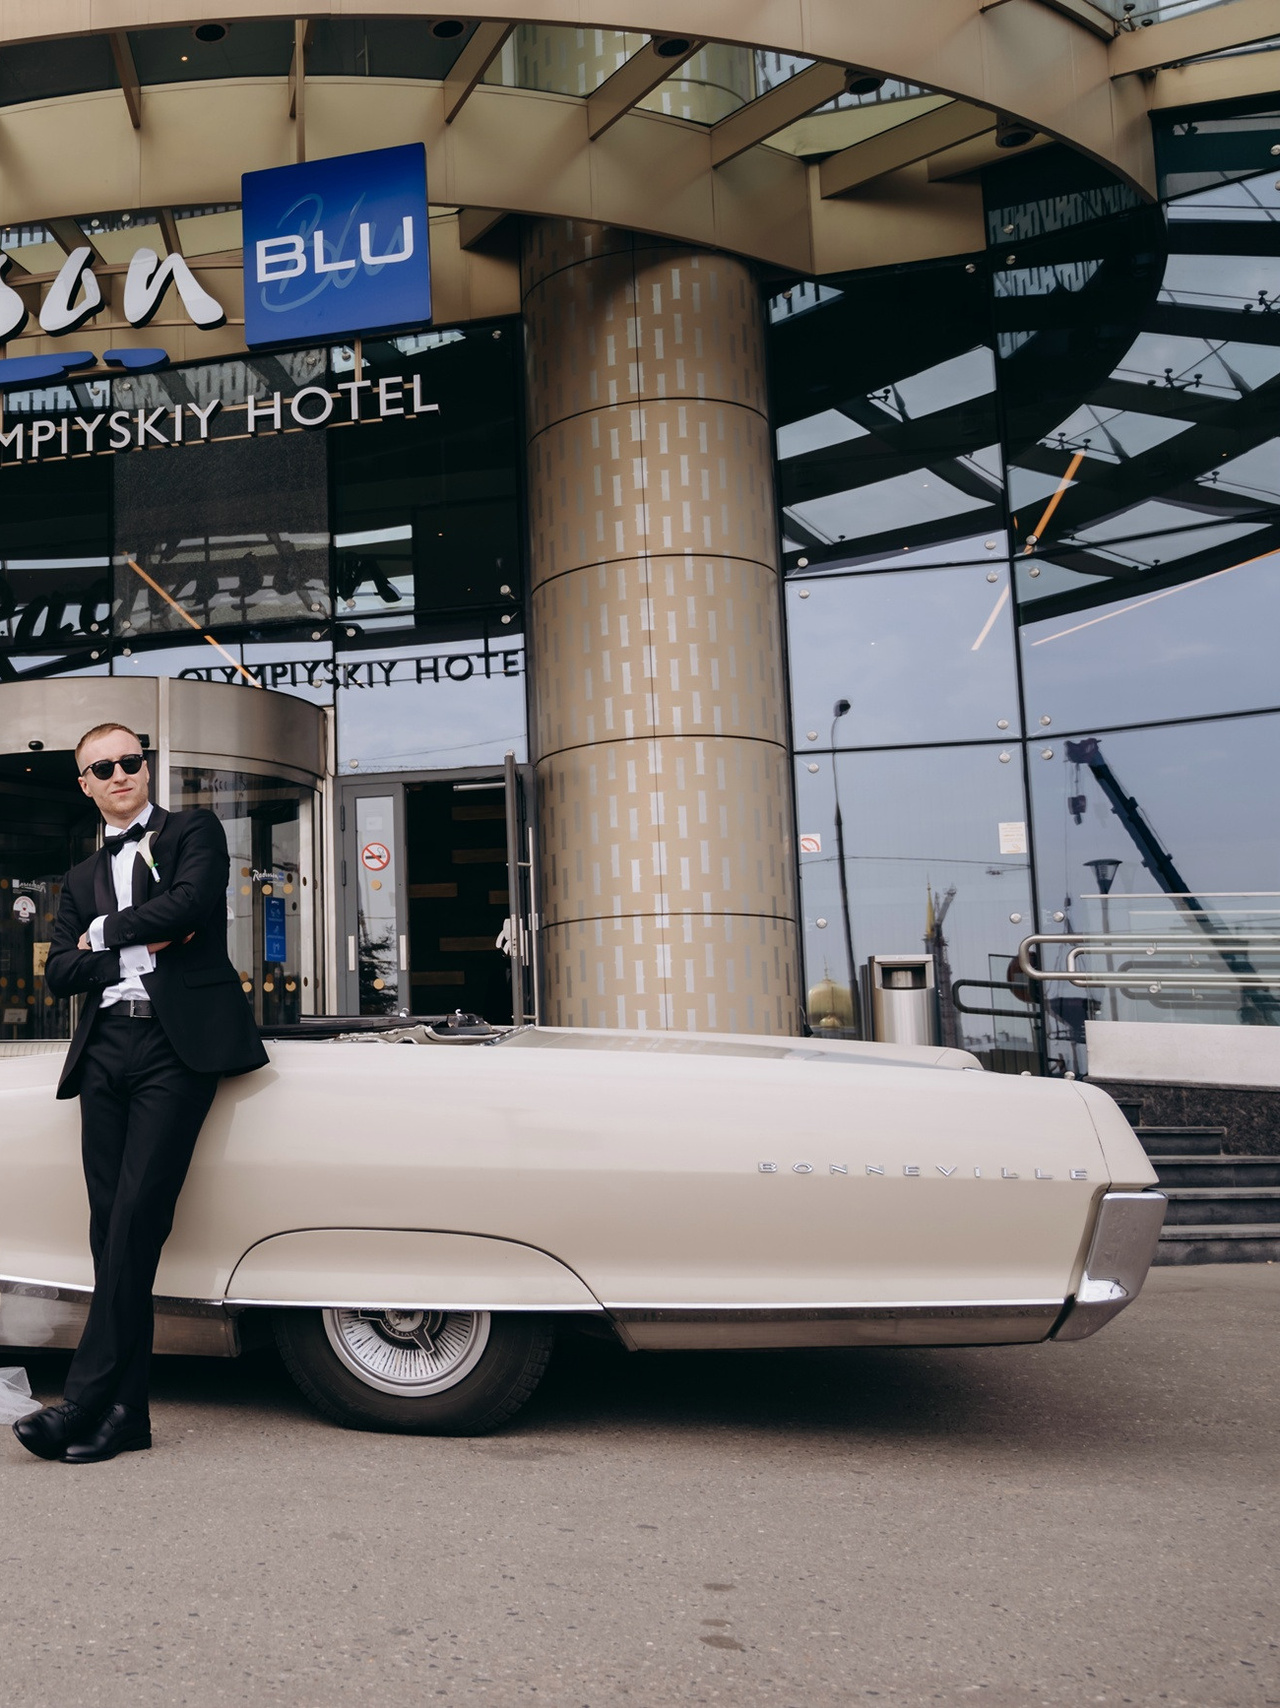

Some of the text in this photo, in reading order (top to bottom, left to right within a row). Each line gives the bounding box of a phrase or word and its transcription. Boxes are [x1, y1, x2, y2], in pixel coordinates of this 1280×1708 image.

[255, 216, 414, 284] BLU
[246, 374, 441, 433] HOTEL
[414, 650, 521, 684] HOTE
[757, 1160, 1089, 1181] BONNEVILLE
